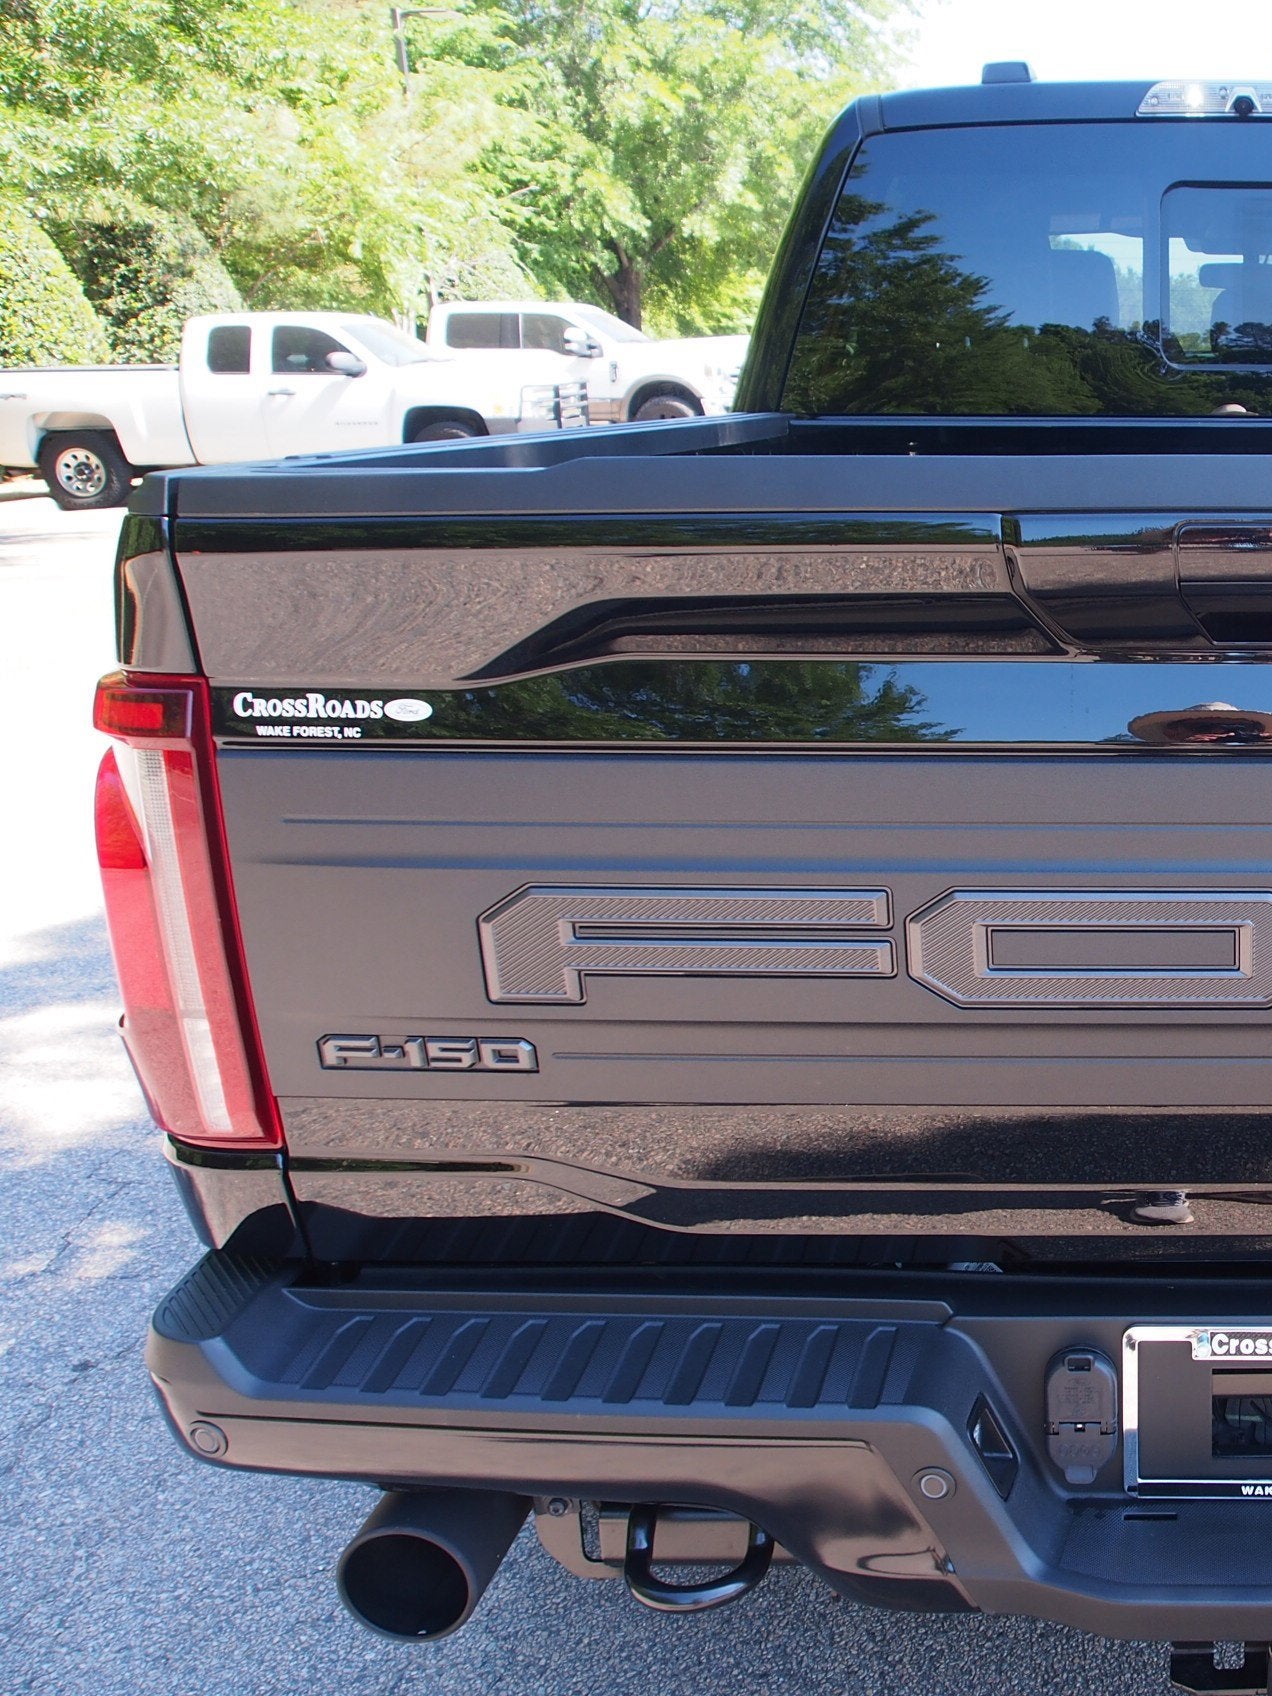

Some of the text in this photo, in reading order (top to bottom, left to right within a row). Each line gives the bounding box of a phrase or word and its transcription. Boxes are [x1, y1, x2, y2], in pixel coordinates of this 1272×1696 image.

[256, 725, 361, 739] WAKE FOREST, NC
[316, 1034, 539, 1073] F-150
